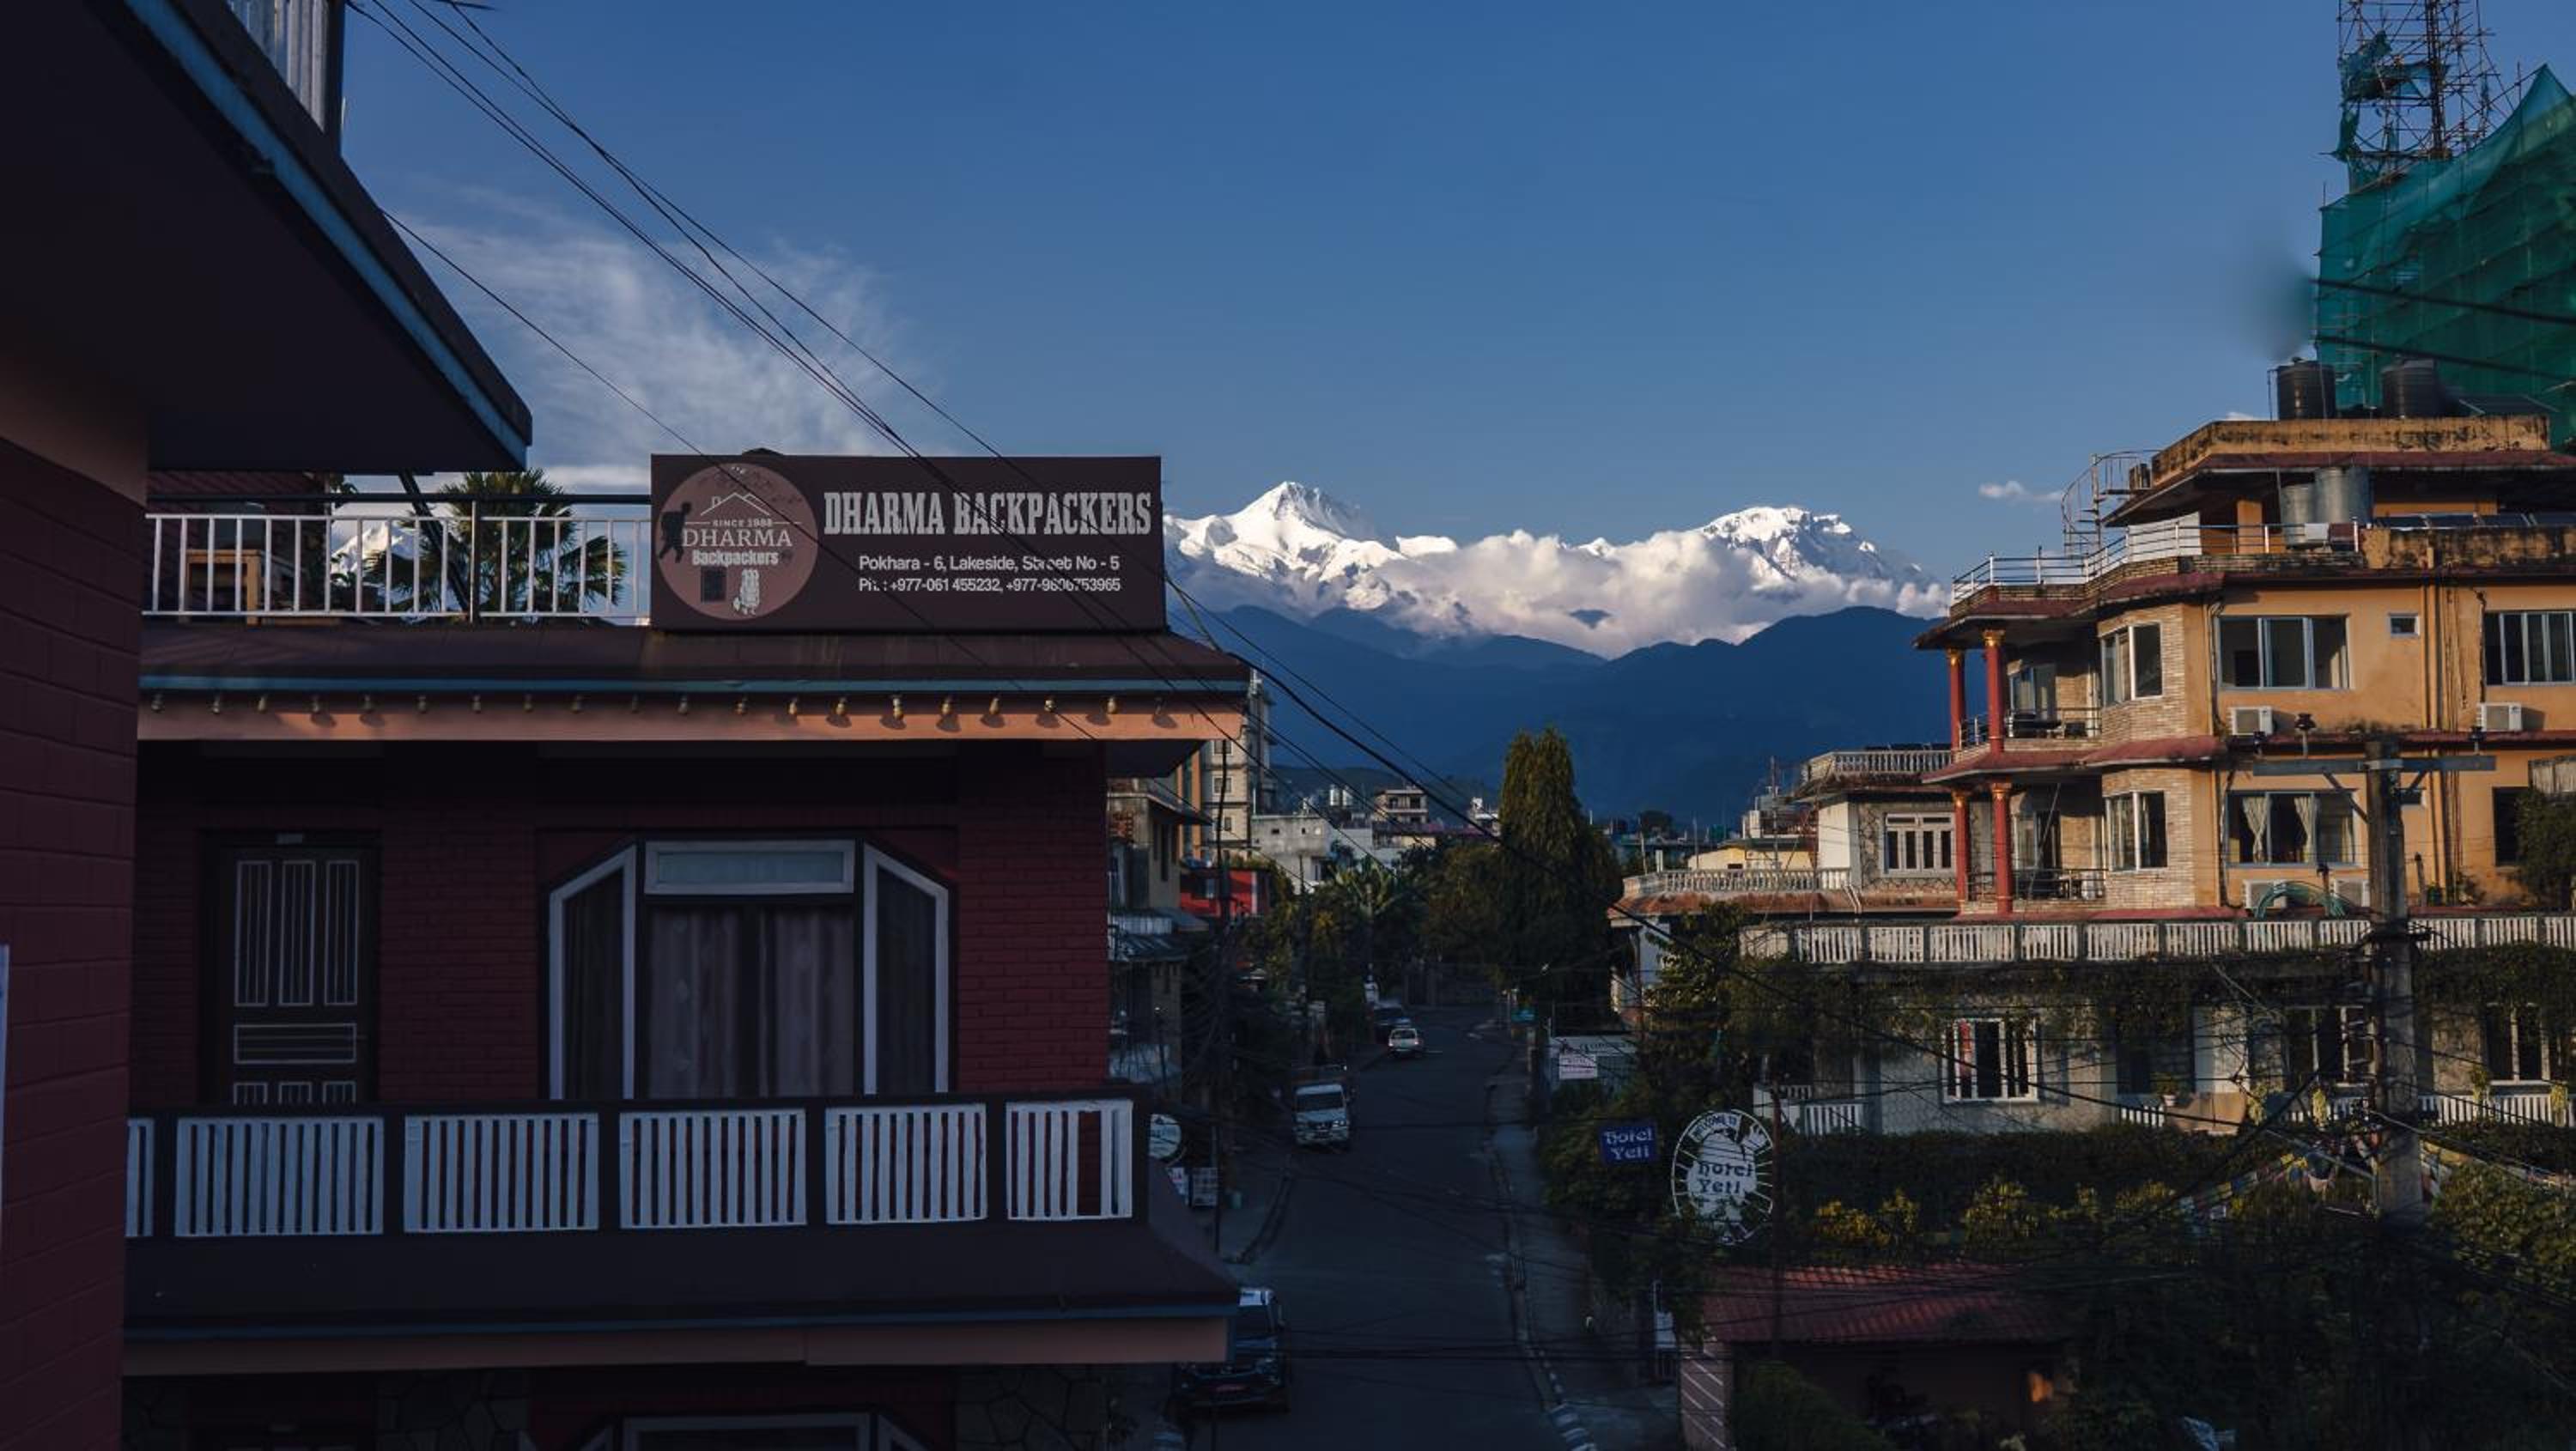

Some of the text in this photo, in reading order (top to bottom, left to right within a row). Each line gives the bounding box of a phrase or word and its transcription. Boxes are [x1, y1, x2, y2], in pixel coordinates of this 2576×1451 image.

[713, 519, 744, 528] SINCE
[823, 492, 1151, 536] DHARMA BACKPACKERS
[682, 528, 793, 547] DHARMA
[692, 549, 779, 568] Backpackers
[859, 556, 920, 570] Pokhara
[933, 556, 946, 574] 6,
[950, 555, 1018, 574] Lakeside,
[1022, 556, 1072, 570] Street
[1076, 556, 1097, 570] No
[1109, 556, 1121, 570] 5
[1610, 1144, 1649, 1161] Yeti
[1698, 1179, 1741, 1194] Yeti
